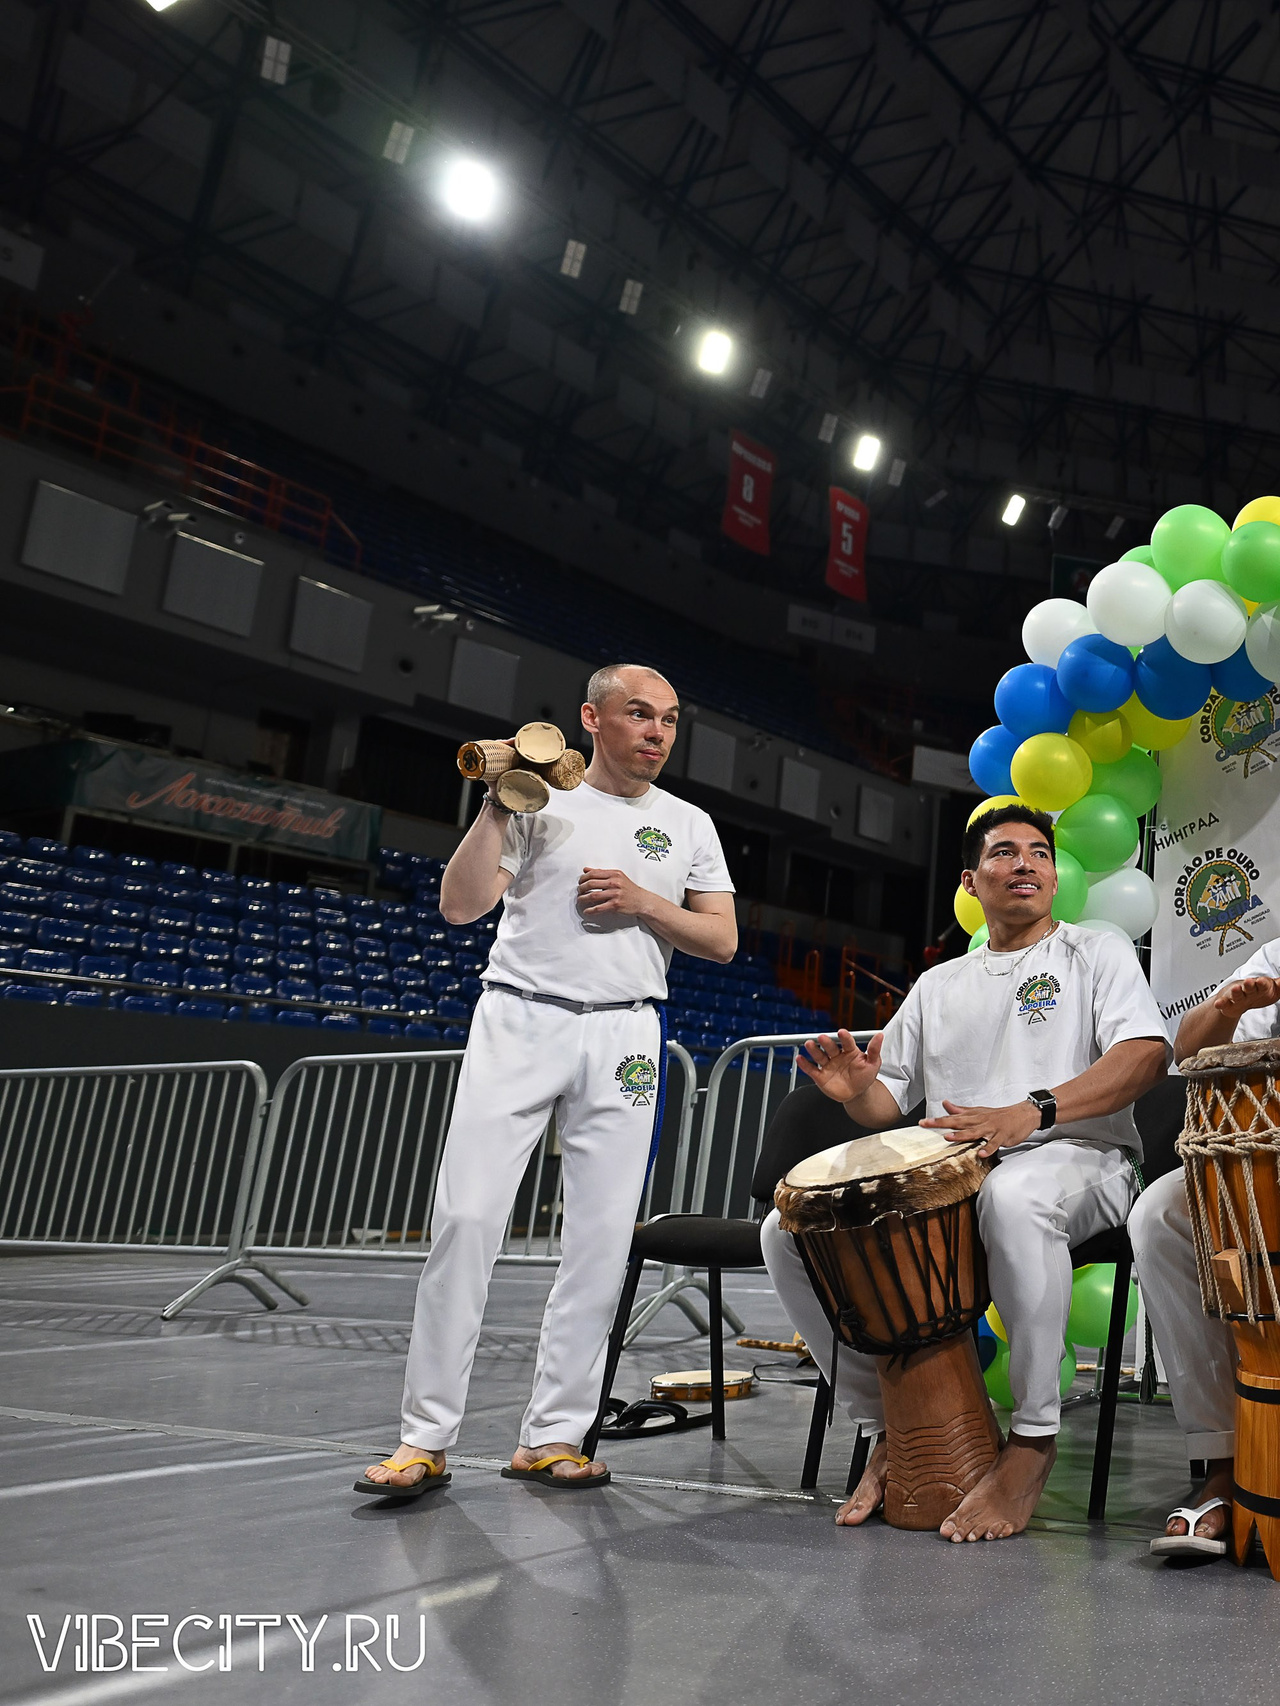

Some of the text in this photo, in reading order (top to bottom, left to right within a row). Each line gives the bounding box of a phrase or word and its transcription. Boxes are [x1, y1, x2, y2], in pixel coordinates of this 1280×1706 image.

[841, 521, 854, 556] 5
[1154, 812, 1219, 852] НИНГРАД
[1174, 847, 1260, 917] CORDÃO DE OURO
[1190, 895, 1264, 938] CAPOEIRA
[1048, 975, 1062, 994] OURO
[1018, 999, 1057, 1012] CAPOEIRA
[619, 1084, 656, 1093] CAPOEIRA
